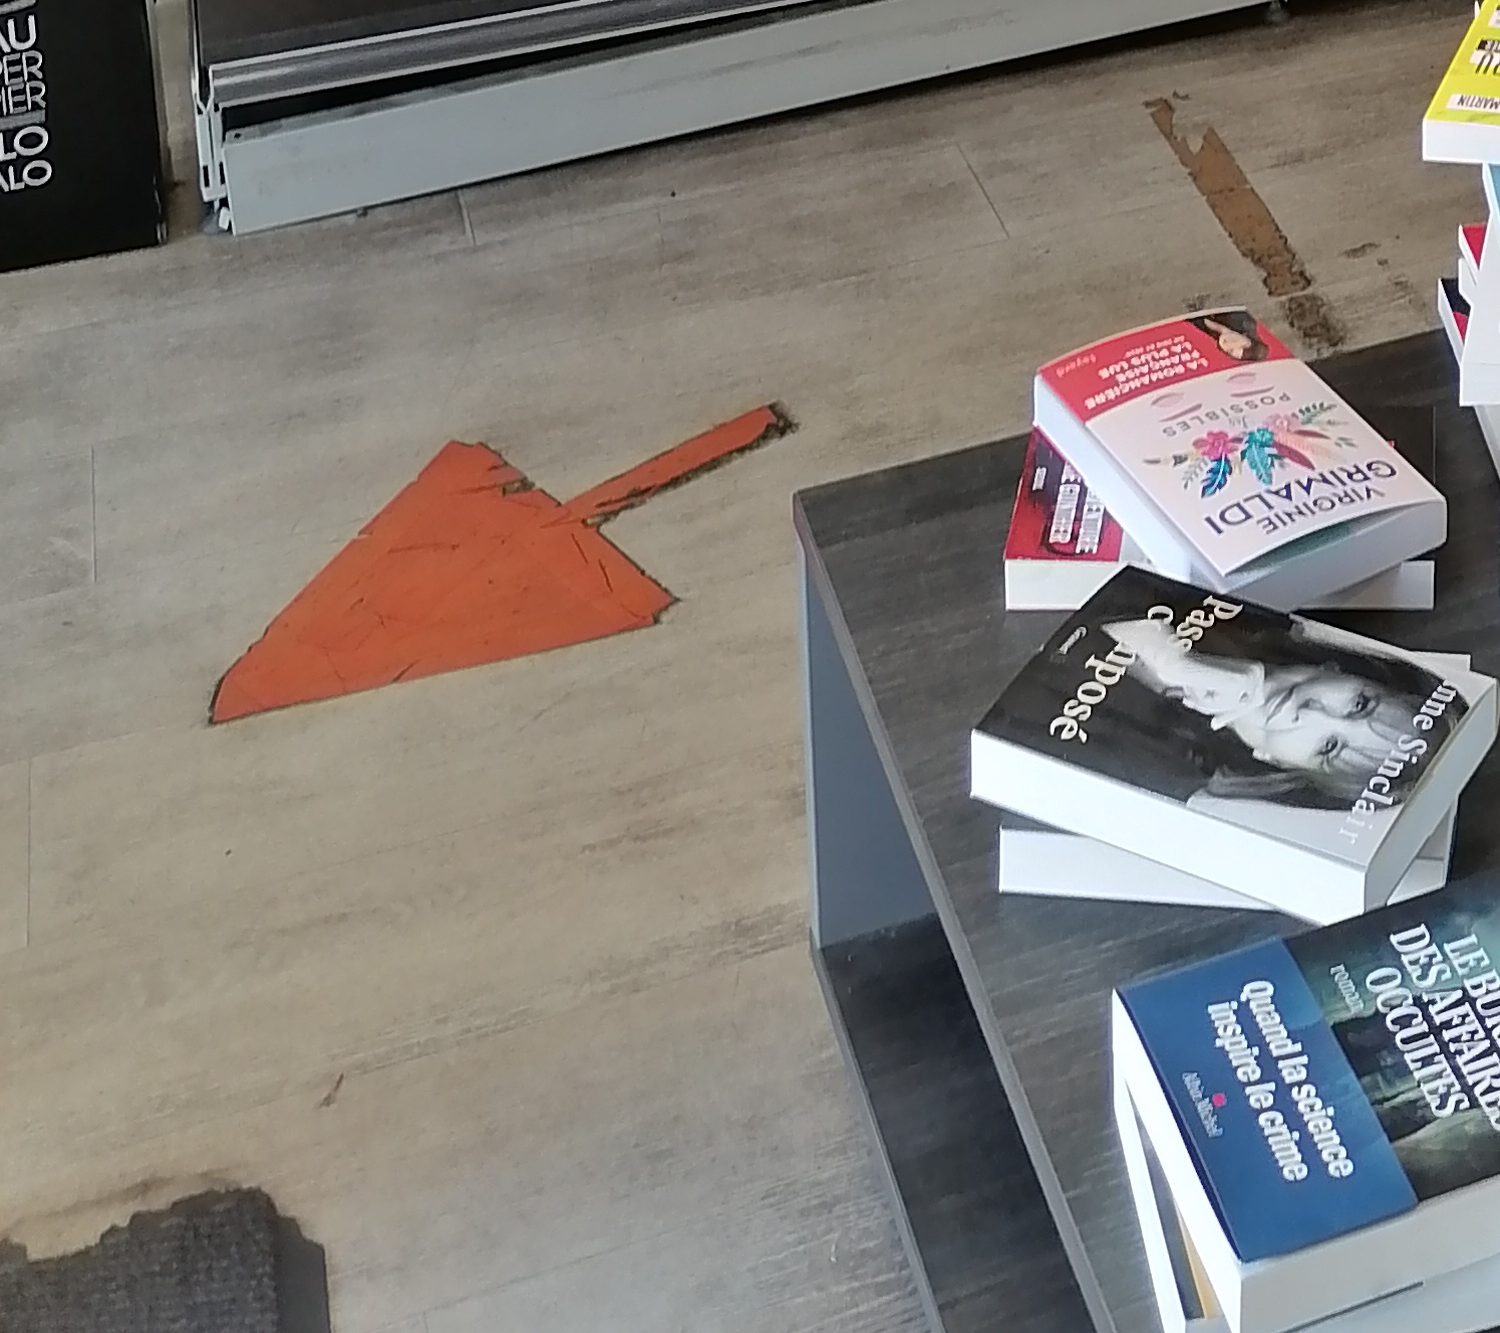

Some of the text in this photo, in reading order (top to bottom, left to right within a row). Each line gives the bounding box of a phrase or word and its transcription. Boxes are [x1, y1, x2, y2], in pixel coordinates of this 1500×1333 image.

[1162, 389, 1293, 439] POSSIBLES
[1203, 459, 1401, 537] GRIMALDI
[1262, 485, 1389, 537] VIRGINIE
[1341, 734, 1431, 846] Sinclair
[1328, 962, 1366, 1016] roman
[1388, 922, 1450, 993] DES
[1239, 978, 1355, 1181] Quand science
[1363, 964, 1471, 1119] OCCULTES
[1207, 1000, 1311, 1184] inspire crime
